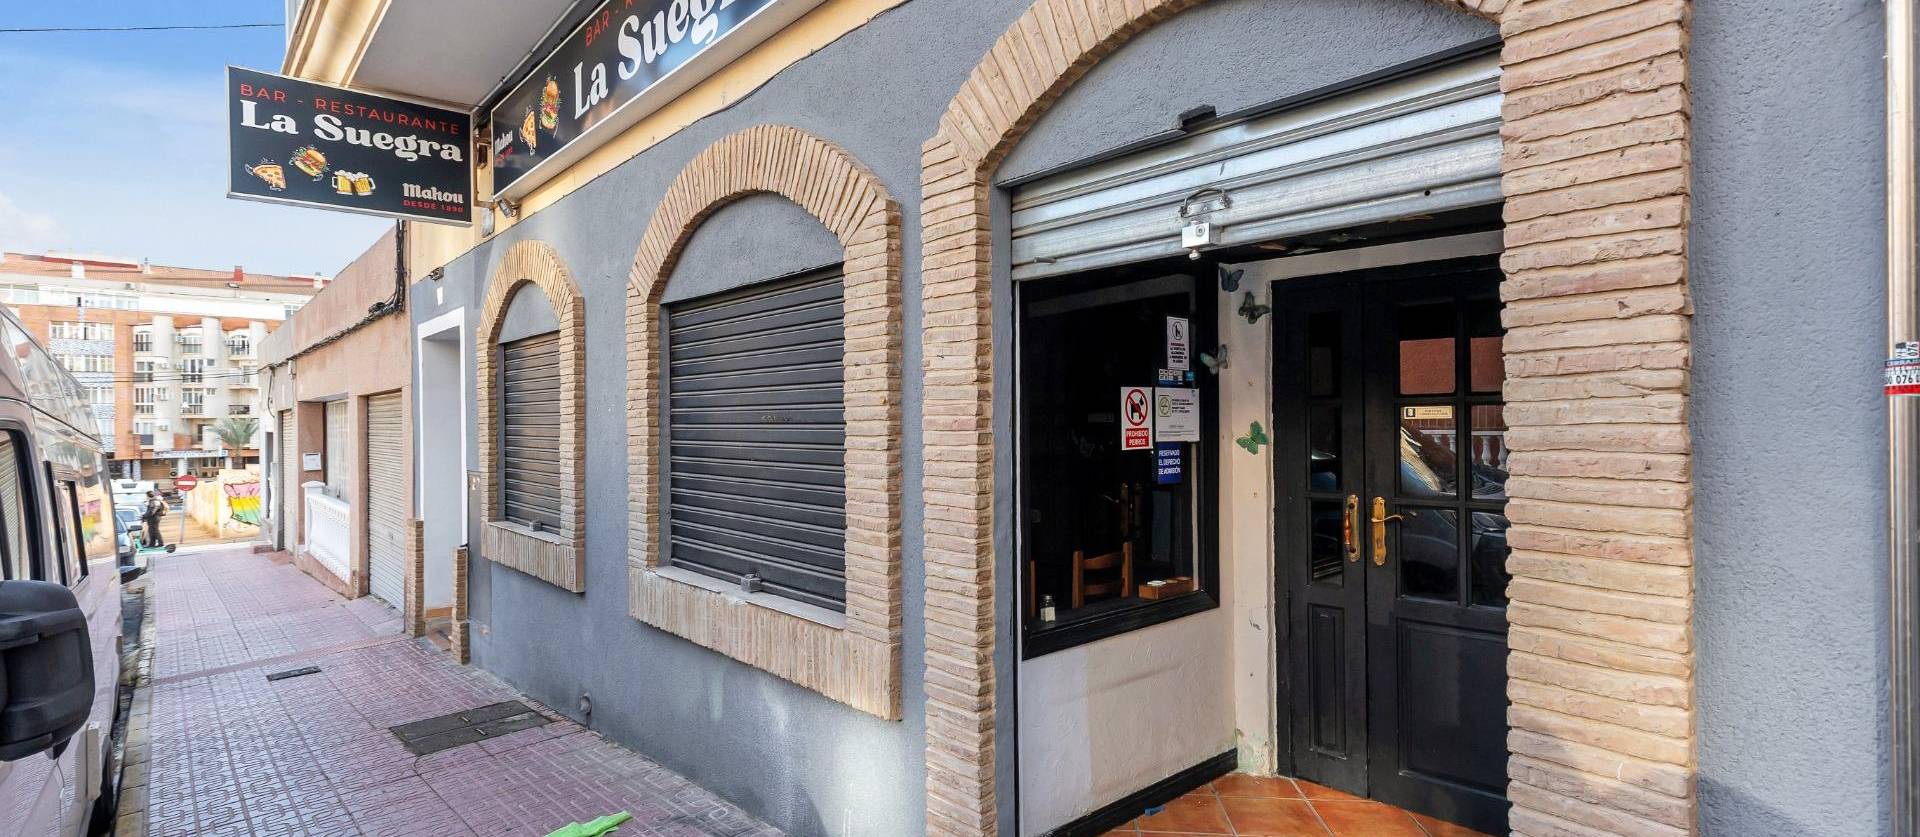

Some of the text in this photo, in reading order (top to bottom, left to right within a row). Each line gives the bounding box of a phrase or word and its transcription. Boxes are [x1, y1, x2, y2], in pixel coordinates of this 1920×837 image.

[585, 10, 609, 48] BAR
[240, 83, 286, 103] BAR
[315, 98, 460, 134] RESTAURANTE
[574, 61, 609, 120] La
[240, 99, 464, 162] La Suegra
[402, 183, 464, 204] Mahou
[403, 200, 438, 211] DESDE
[1896, 375, 1914, 384] 076
